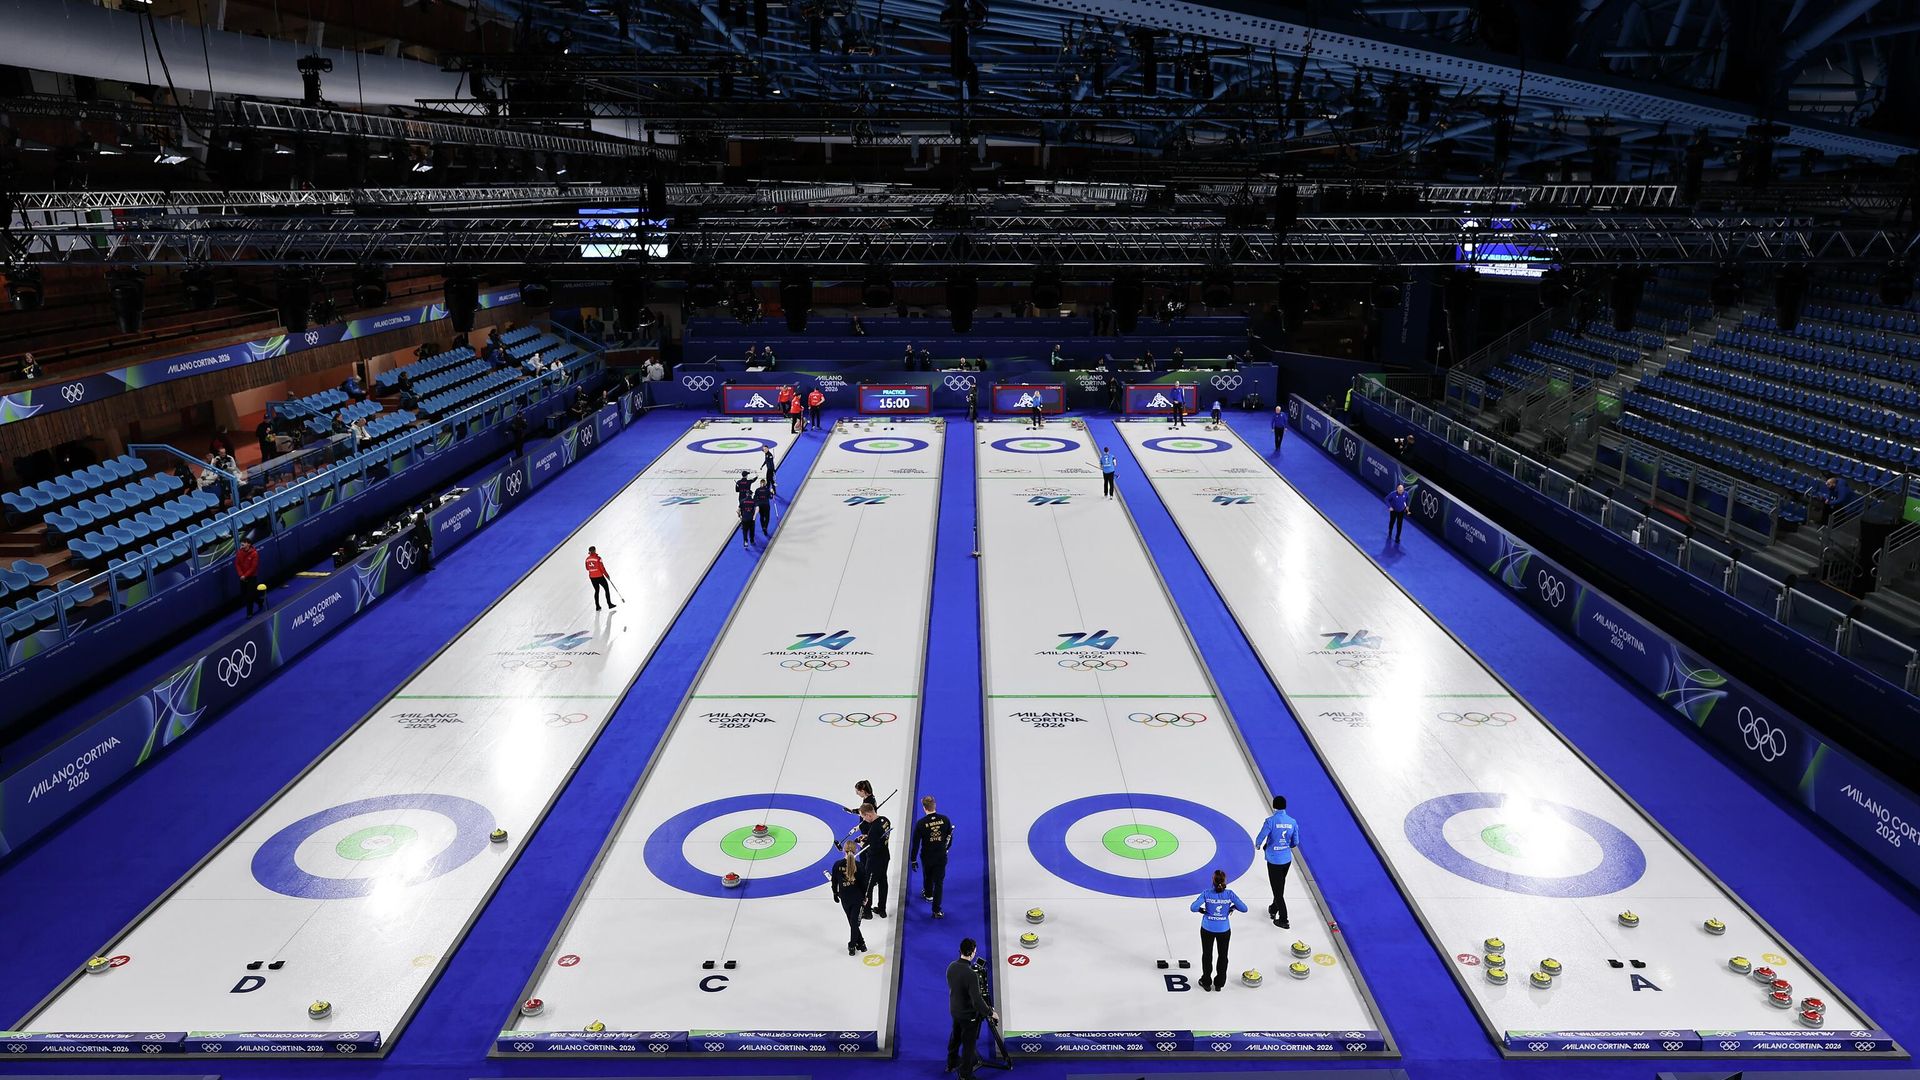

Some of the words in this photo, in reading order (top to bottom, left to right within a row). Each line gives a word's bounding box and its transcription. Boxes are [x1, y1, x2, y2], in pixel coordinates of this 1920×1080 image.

[168, 362, 193, 374] MILANO
[193, 358, 219, 370] CORTINA
[218, 353, 231, 363] 2026
[879, 398, 910, 409] 15:00
[440, 516, 456, 532] MILANO
[456, 507, 472, 522] CORTINA
[453, 523, 462, 532] 2026
[1455, 517, 1470, 531] MILANO
[1470, 526, 1487, 543] CORTINA
[292, 606, 317, 629] MILANO
[317, 592, 342, 613] CORTINA
[312, 614, 325, 627] 2026
[1593, 612, 1618, 634] MILANO
[1618, 626, 1646, 654] CORTINA
[1610, 634, 1624, 650] 2026
[28, 764, 75, 803] MILANO
[76, 736, 121, 770] CORTINA
[67, 769, 90, 792] 2026
[1840, 785, 1890, 822] MILANO
[1892, 816, 1920, 846] CORT
[1876, 822, 1901, 848] 2026
[229, 975, 267, 993] D
[699, 974, 730, 992] C
[1163, 974, 1191, 992] B
[1630, 974, 1663, 992] A
